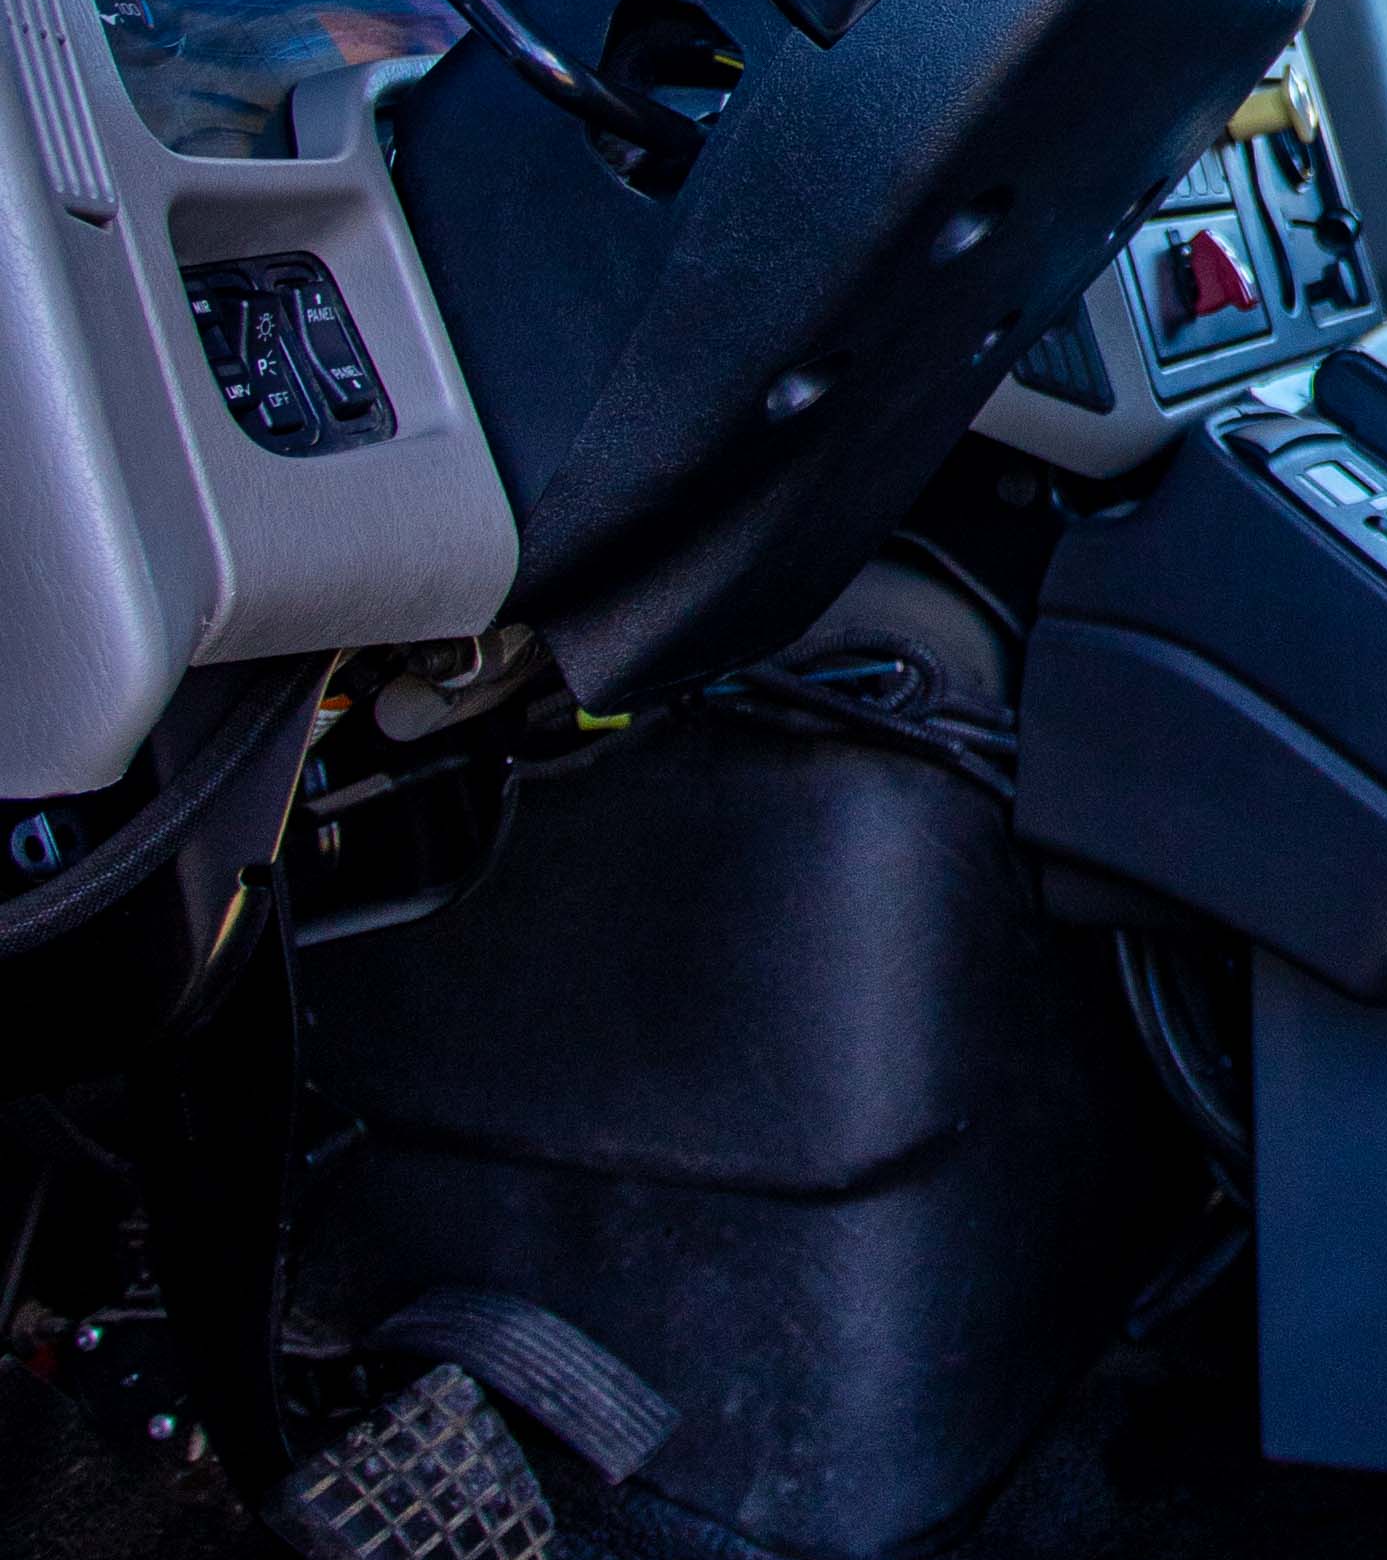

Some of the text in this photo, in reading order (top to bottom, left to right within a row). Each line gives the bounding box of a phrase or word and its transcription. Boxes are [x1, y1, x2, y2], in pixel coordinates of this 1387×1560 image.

[307, 306, 336, 323] PANEL
[330, 365, 364, 381] PANEL
[267, 391, 289, 408] OFF
